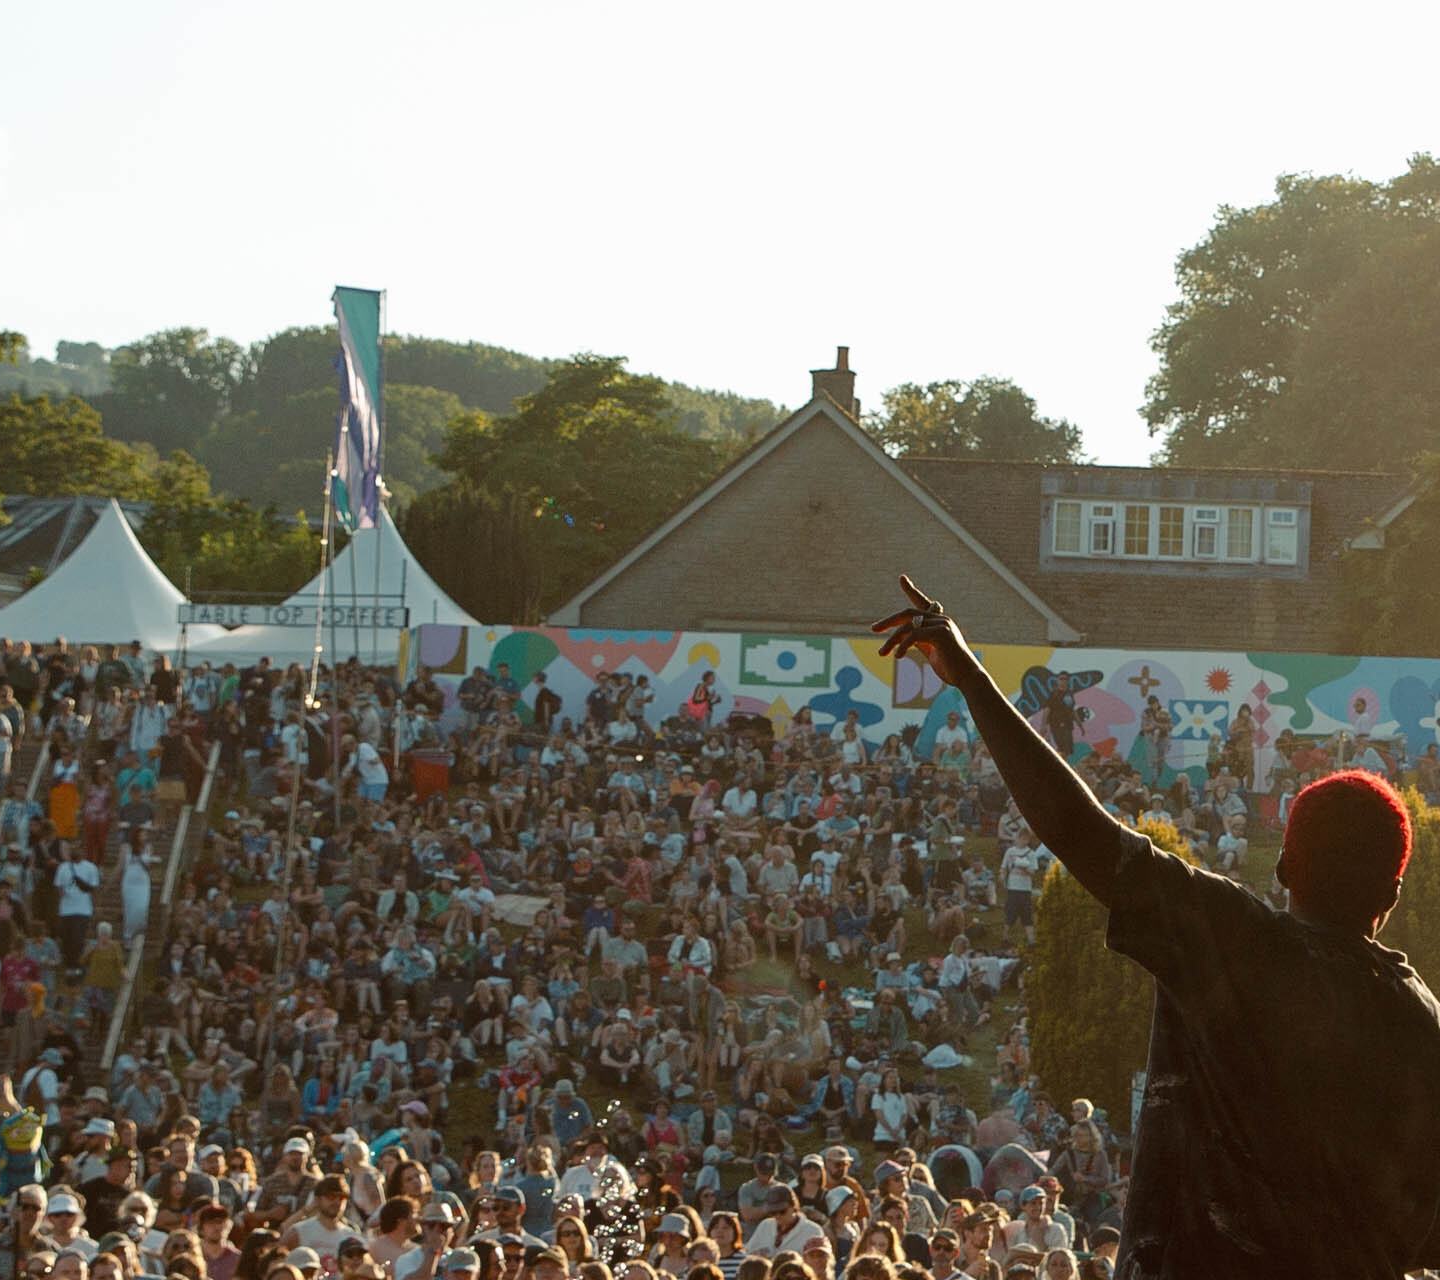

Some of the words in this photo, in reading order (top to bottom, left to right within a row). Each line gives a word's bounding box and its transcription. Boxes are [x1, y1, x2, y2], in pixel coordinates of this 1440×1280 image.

[189, 606, 249, 624] TABLE
[264, 607, 304, 624] TOP
[315, 608, 396, 626] COFFEE
